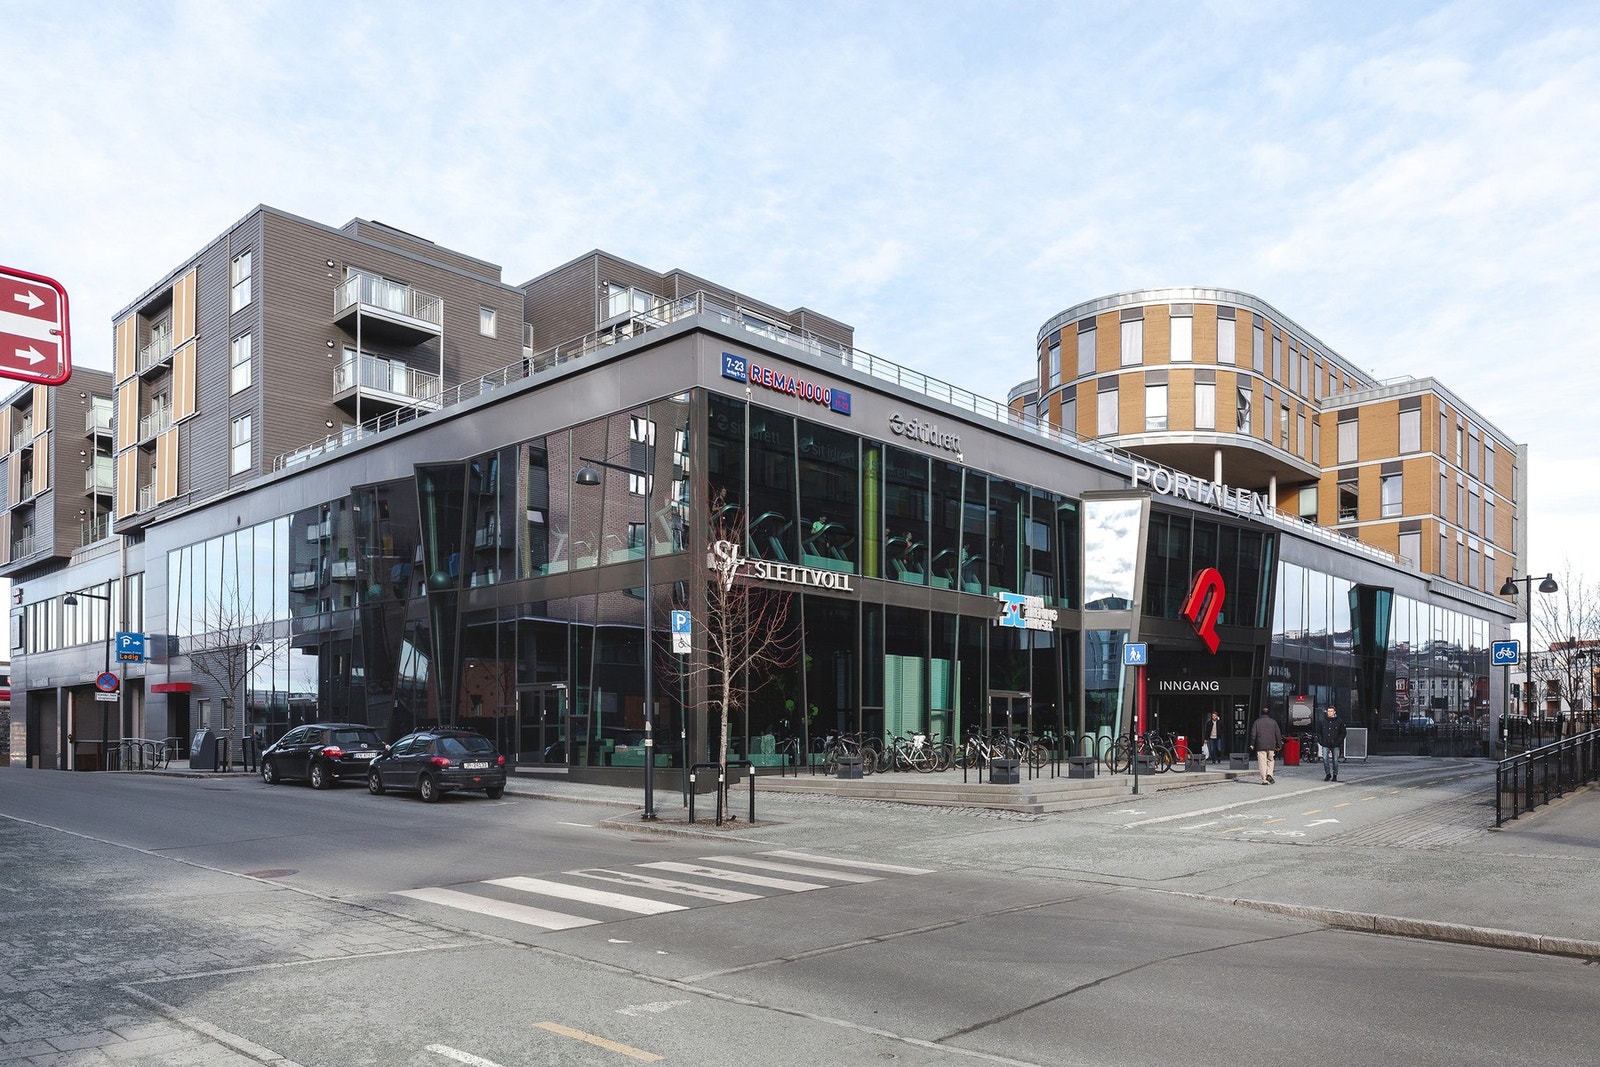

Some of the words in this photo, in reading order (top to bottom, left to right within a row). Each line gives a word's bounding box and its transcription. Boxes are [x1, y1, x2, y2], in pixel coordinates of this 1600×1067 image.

[726, 357, 744, 372] 7-23
[1131, 462, 1269, 517] PORTALEN
[754, 561, 854, 591] SLETTVOLL
[677, 613, 687, 631] P
[122, 638, 131, 648] P
[1159, 680, 1220, 692] INNGANG
